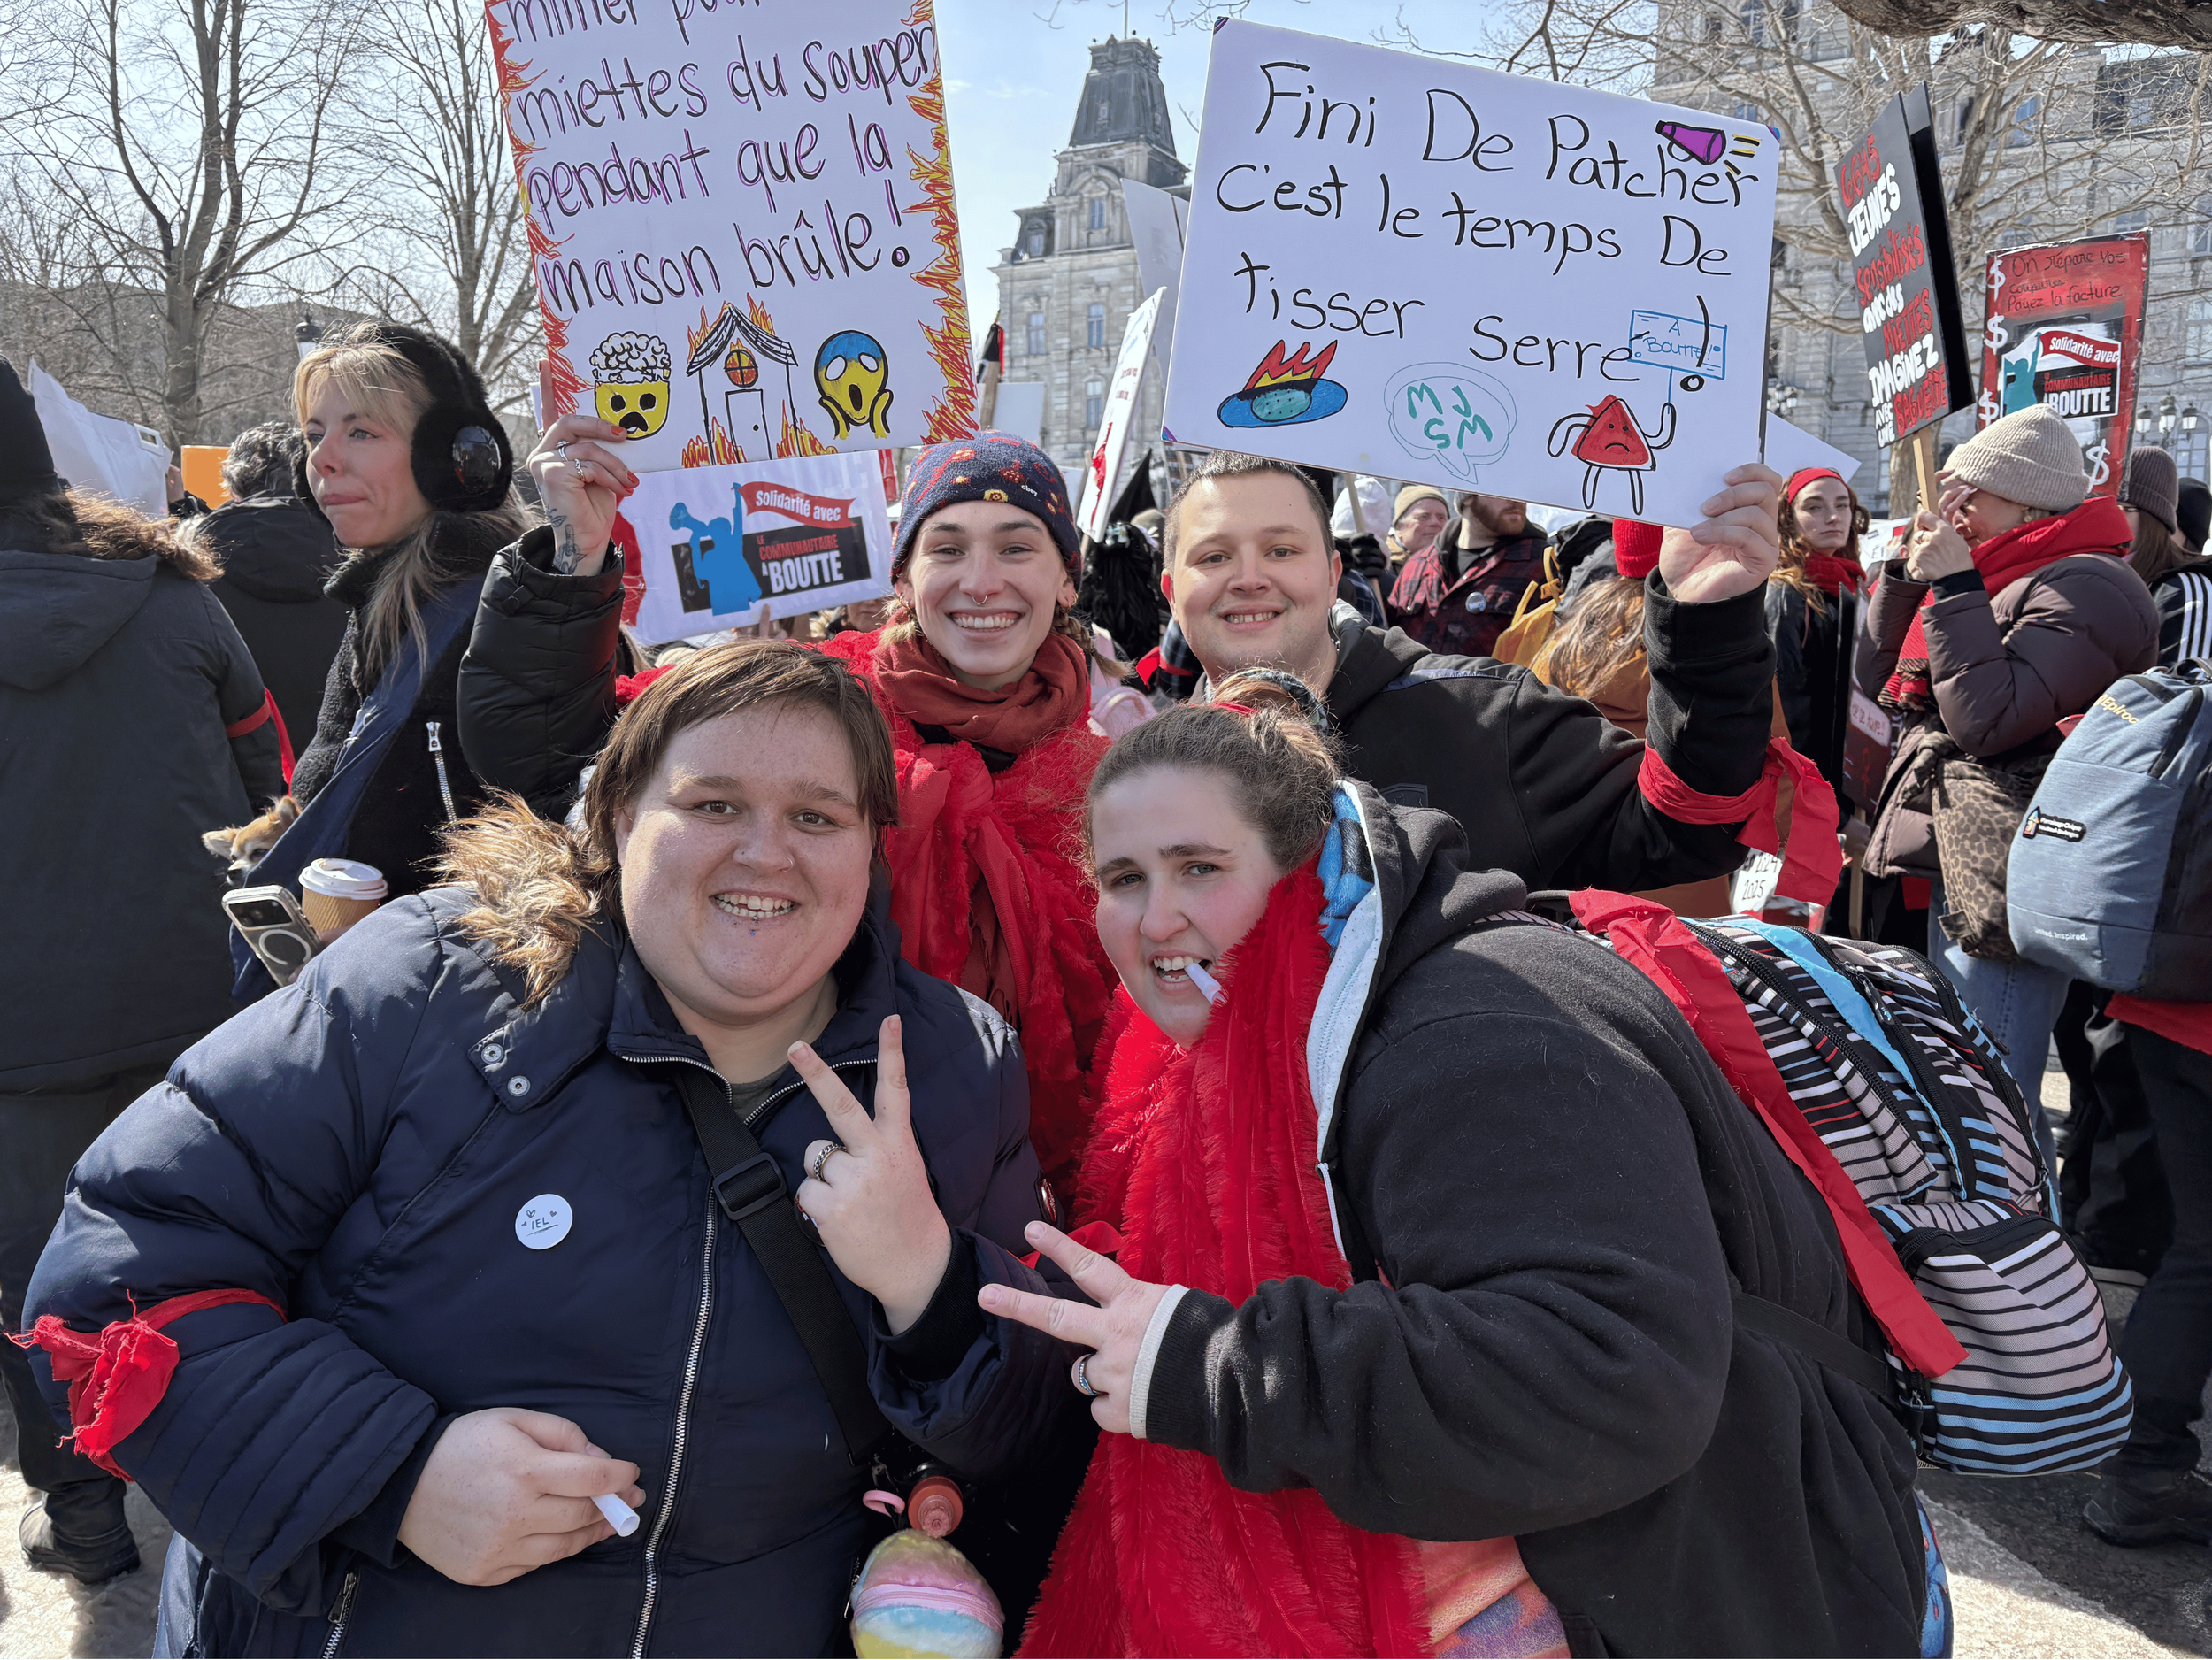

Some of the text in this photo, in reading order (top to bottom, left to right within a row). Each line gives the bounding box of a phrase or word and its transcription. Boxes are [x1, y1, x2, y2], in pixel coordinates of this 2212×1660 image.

[516, 58, 707, 140] miettes
[727, 35, 788, 111] du
[1255, 62, 1758, 206] Fini De Patcher
[530, 113, 893, 234] pendant que la
[1217, 164, 1731, 275] C'est le temps De
[1847, 162, 1901, 257] JEUNES
[541, 179, 910, 313] maison brûle!
[2012, 256, 2038, 277] On
[2008, 281, 2123, 311] Payez la facture
[2094, 350, 2119, 363] avec
[2044, 373, 2112, 392] COMMUNAUTAIRE
[2048, 386, 2112, 417] BOUTTE
[813, 505, 841, 522] avec
[759, 534, 839, 561] COMMUNAUTAIRE
[768, 550, 844, 594] BOUTTE
[532, 1217, 549, 1230] IEL
